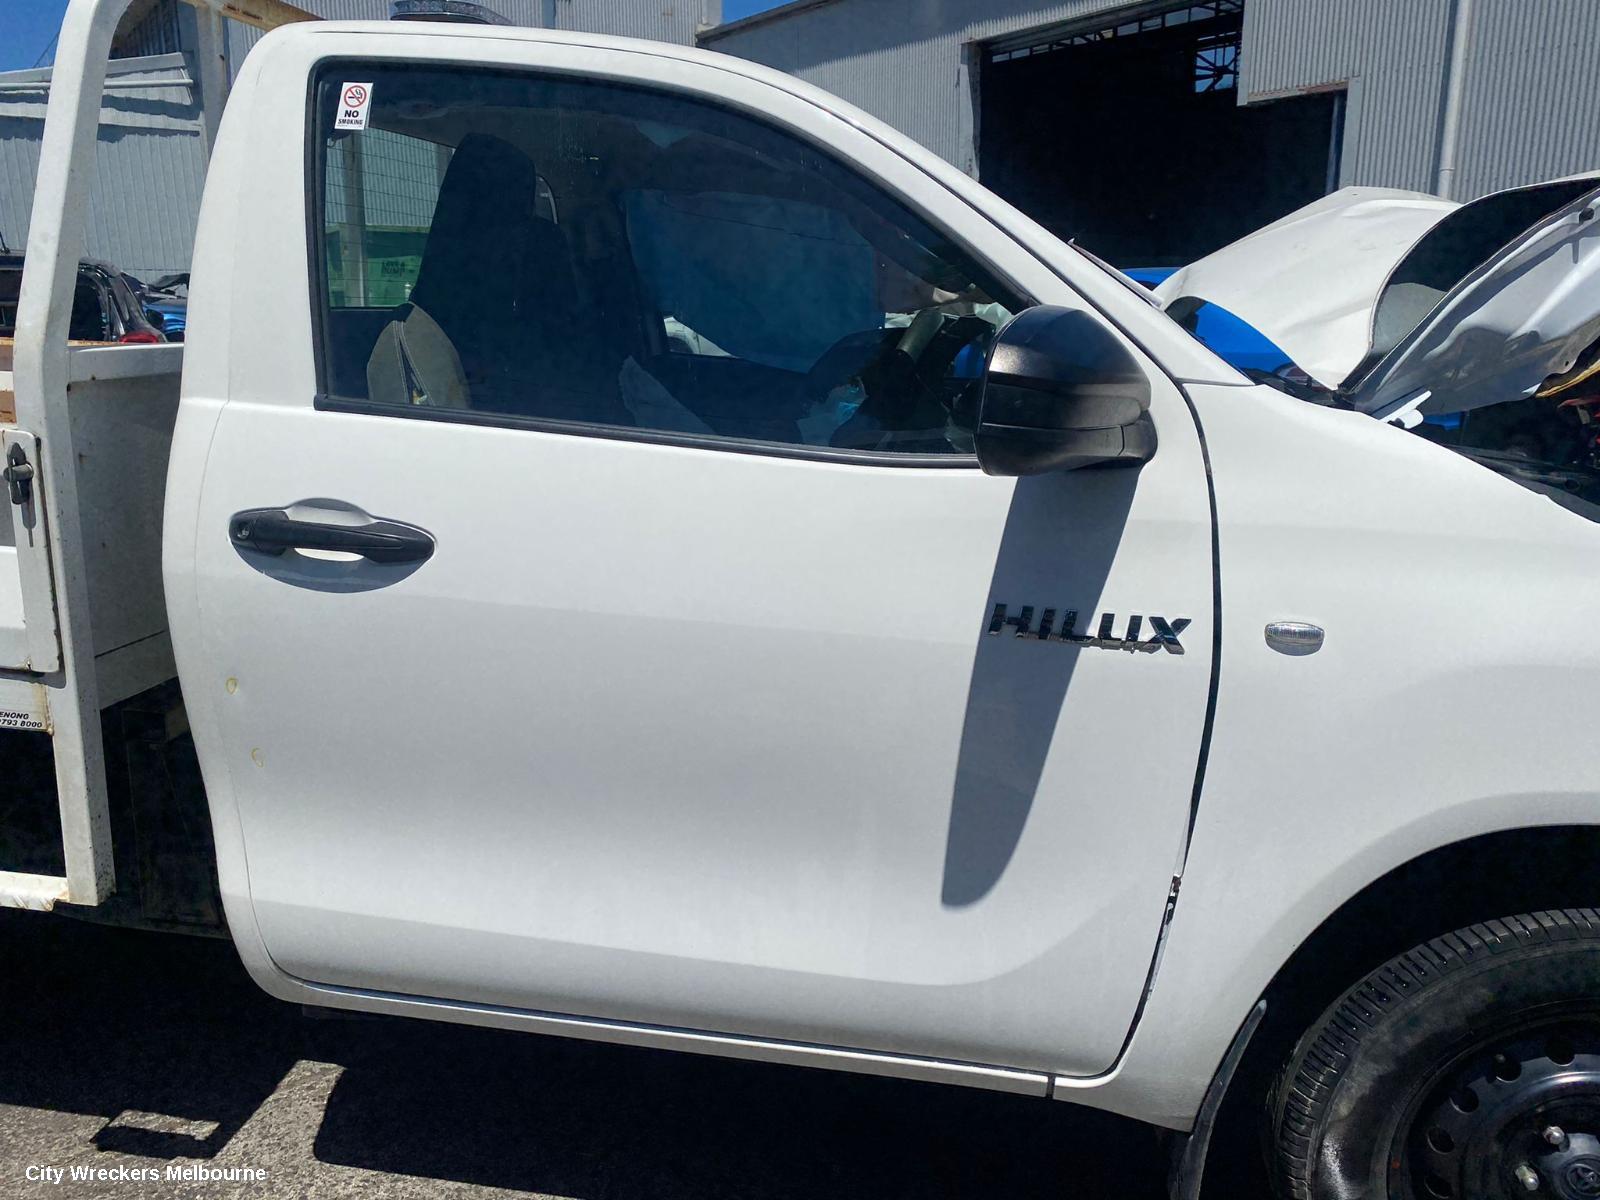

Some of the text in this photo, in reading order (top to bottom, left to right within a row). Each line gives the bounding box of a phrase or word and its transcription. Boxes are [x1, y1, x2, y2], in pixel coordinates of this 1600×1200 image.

[344, 110, 359, 118] NO
[988, 603, 1192, 655] HILUX
[20, 720, 43, 728] 8000
